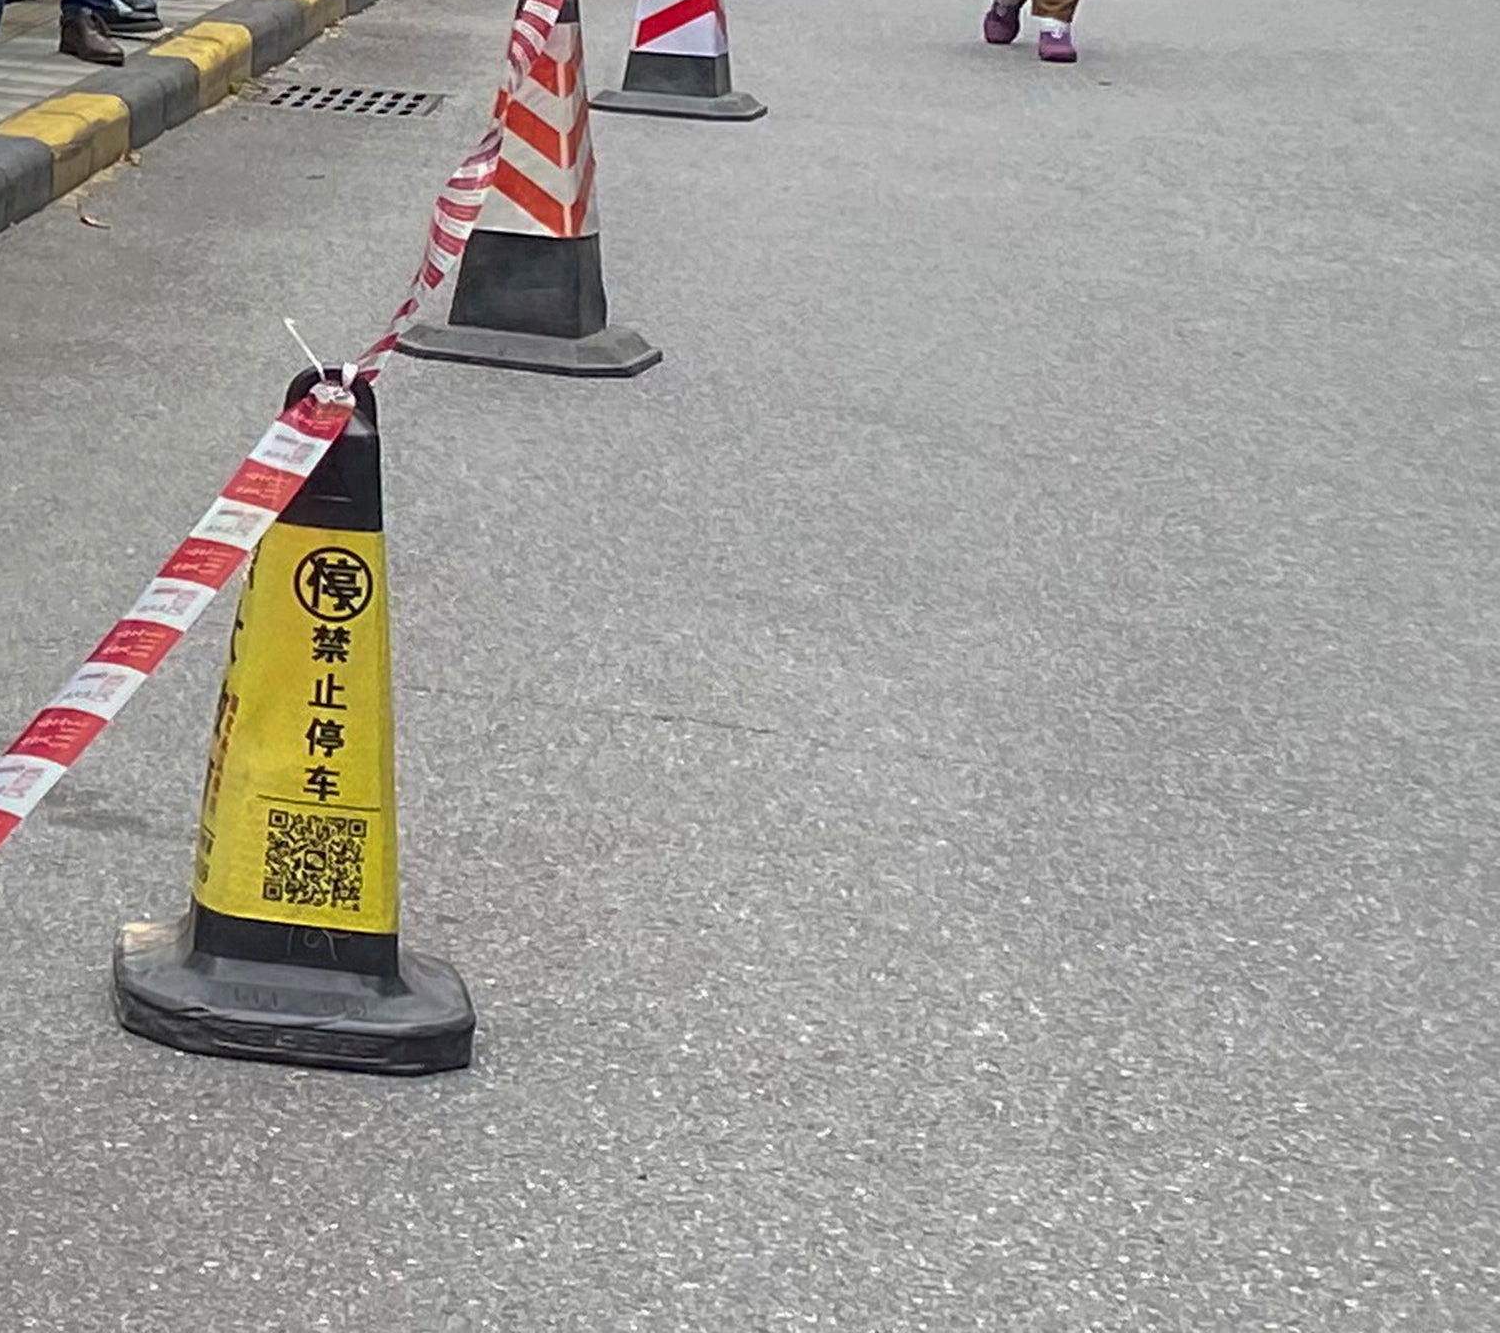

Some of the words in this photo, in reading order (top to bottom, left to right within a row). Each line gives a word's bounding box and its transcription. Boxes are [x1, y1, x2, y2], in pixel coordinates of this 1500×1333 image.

[306, 556, 363, 612] 停
[302, 624, 352, 802] 禁止停车
